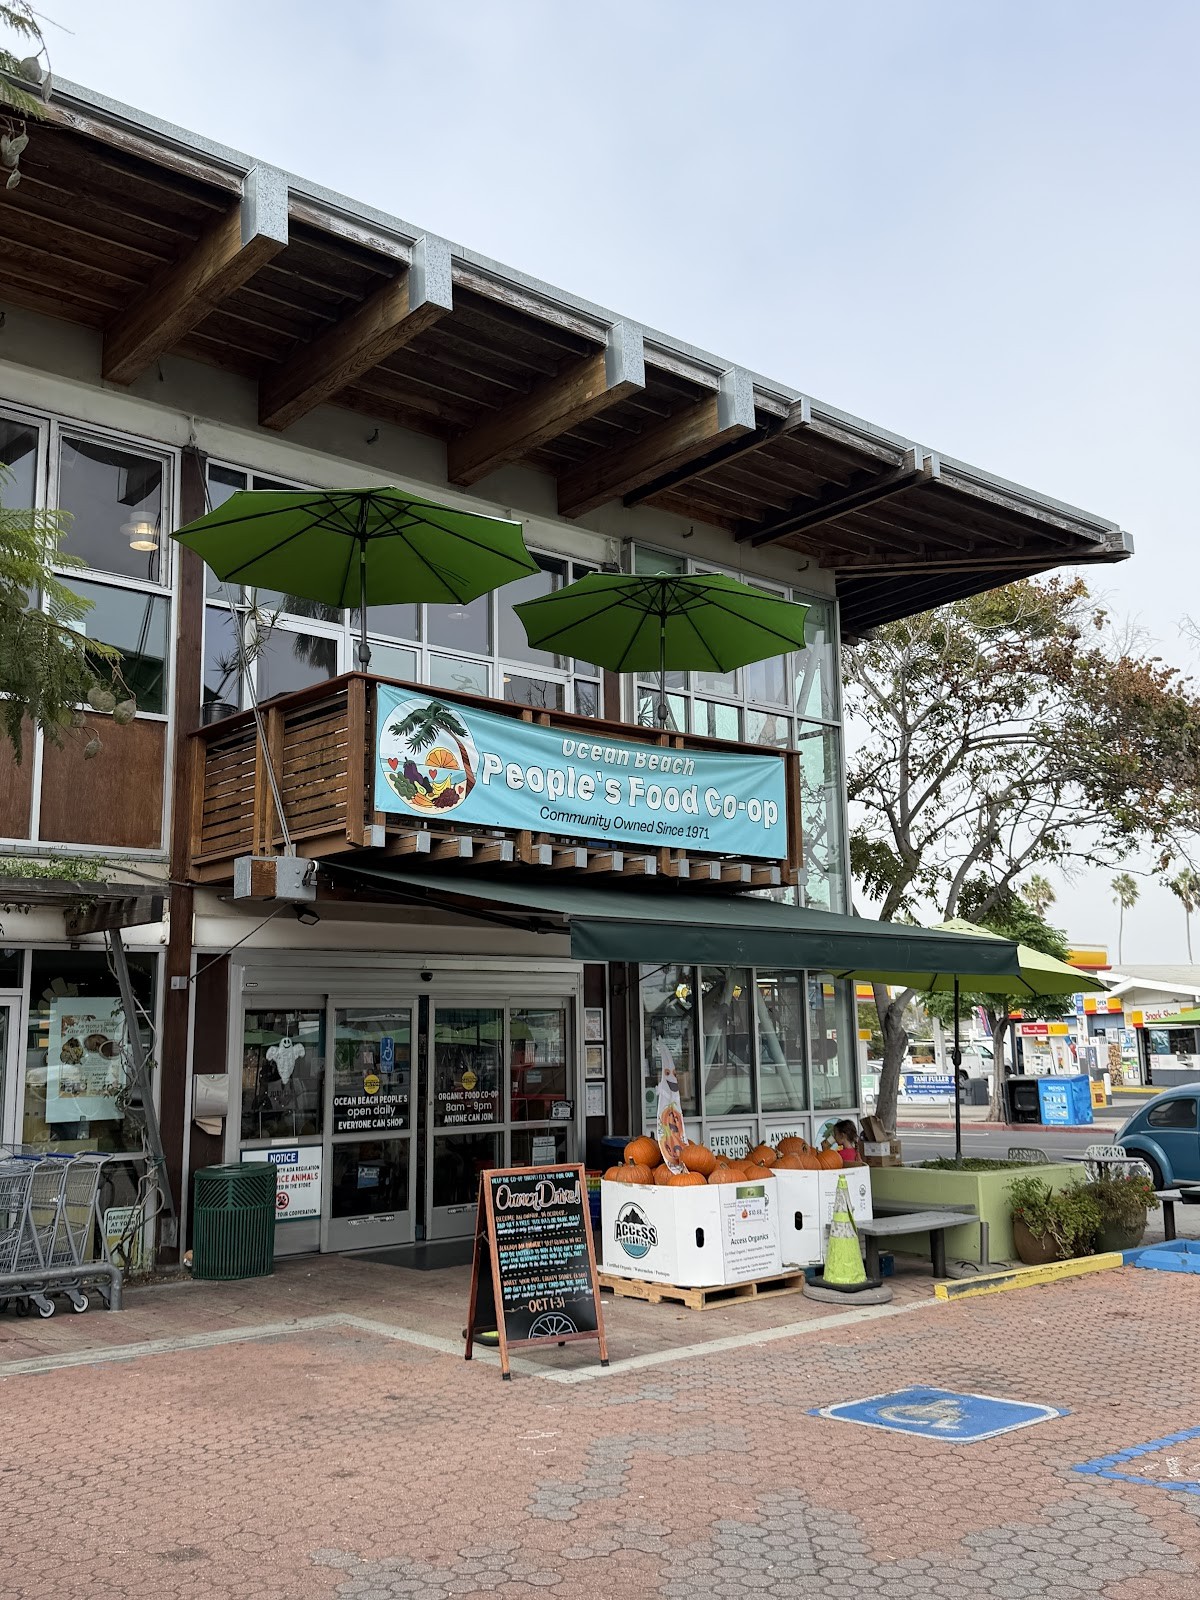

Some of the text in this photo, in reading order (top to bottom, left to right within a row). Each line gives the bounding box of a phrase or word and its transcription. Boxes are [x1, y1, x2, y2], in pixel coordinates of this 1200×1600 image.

[562, 737, 696, 777] Ocean Beach
[481, 751, 780, 830] People's Food Co-op
[540, 805, 711, 841] Community Owned Since 1971
[1146, 1010, 1162, 1020] Snack
[334, 1094, 408, 1106] OCEAN BEACH PEOPLE'S
[438, 1090, 498, 1100] ORGANIC FOOD CO-OP
[348, 1105, 396, 1118] open daily
[446, 1102, 464, 1112] 8am
[474, 1101, 492, 1112] 9pm
[338, 1118, 403, 1130] EVERYONE CAN SHOP
[444, 1114, 468, 1122] ANYONE
[468, 1114, 480, 1122] CAN
[711, 1135, 748, 1146] EVERYONE
[270, 1153, 296, 1163] NOTICE
[291, 1173, 318, 1182] ANIMALS
[496, 1180, 580, 1211] Owner Drive!
[615, 1222, 657, 1244] ACCESS
[620, 1236, 651, 1246] ORGANICS
[730, 1233, 769, 1246] Access Organics
[528, 1296, 566, 1312] OCT 1-31
